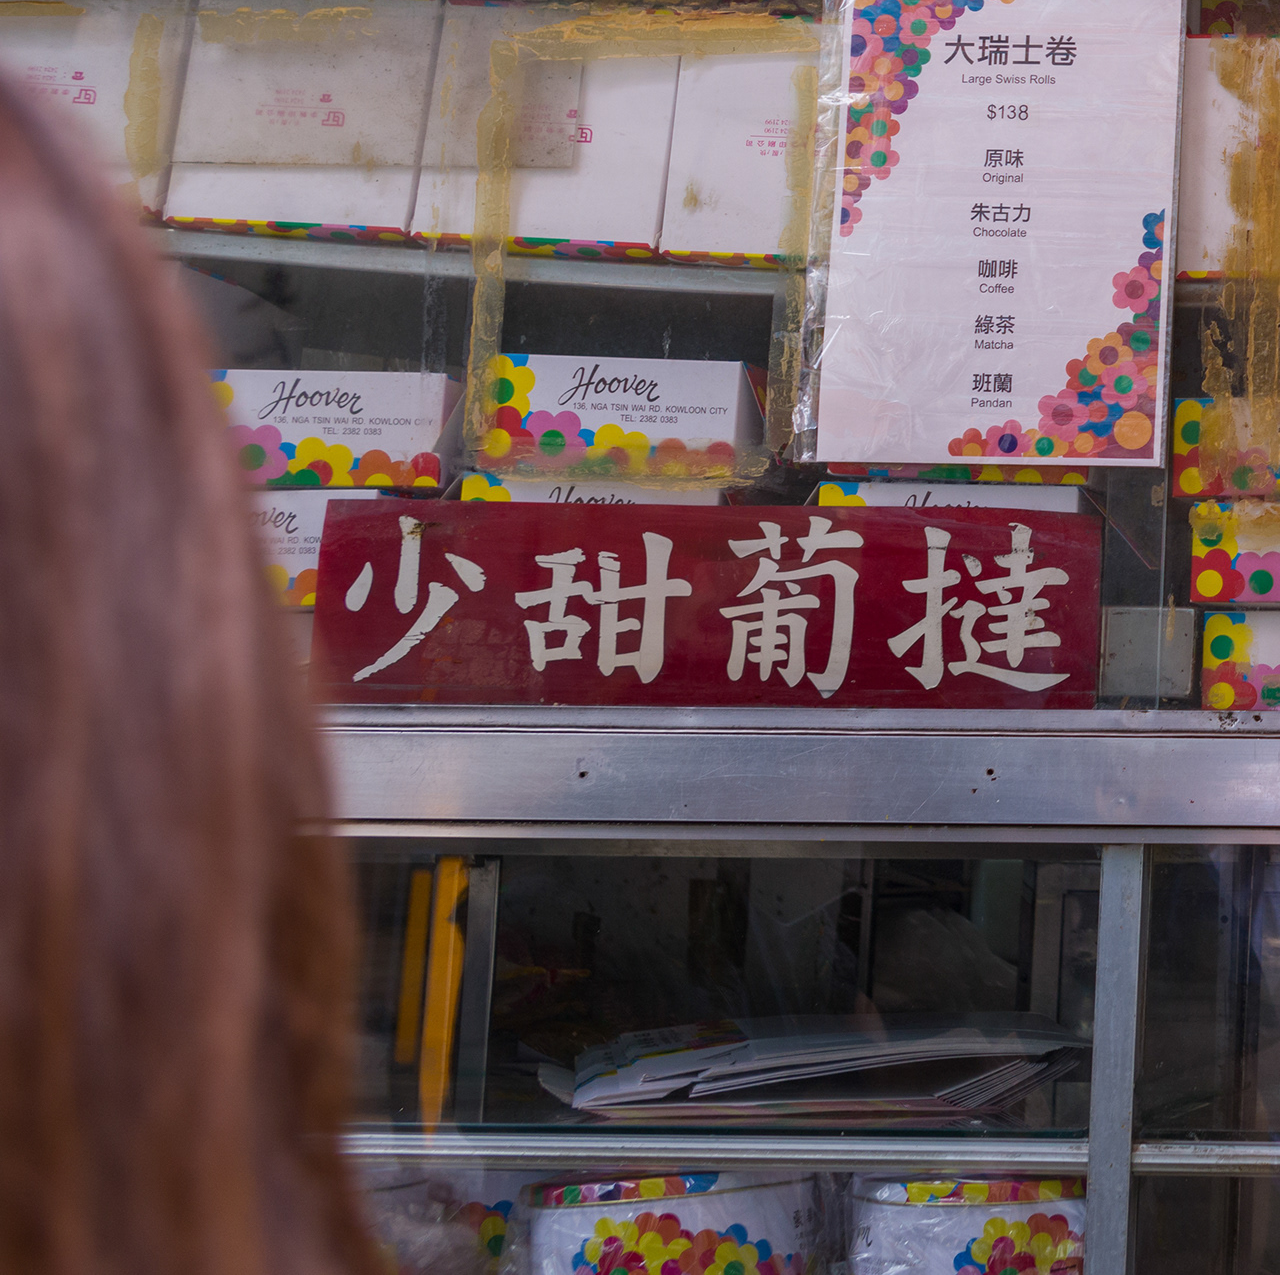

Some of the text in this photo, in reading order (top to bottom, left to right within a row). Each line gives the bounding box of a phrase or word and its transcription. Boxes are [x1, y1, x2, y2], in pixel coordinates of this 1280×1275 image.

[943, 34, 1077, 66] 大瑞士卷
[961, 74, 1056, 86] Large Swiss Rolls
[986, 103, 1029, 120] $138
[984, 148, 1024, 168] 原味
[982, 172, 1024, 185] Original
[970, 203, 1031, 223] 朱古力
[973, 227, 1027, 238] Chocolate
[977, 259, 1018, 279] 咖啡
[979, 283, 1015, 294] Coffee
[974, 314, 1015, 335] 綠茶
[974, 340, 1014, 350] Matcha
[558, 364, 660, 406] Hoover
[972, 373, 1013, 393] 班蘭
[258, 378, 363, 419] Hoover
[971, 397, 1013, 408] Pandan
[573, 402, 588, 411] 136,
[590, 403, 608, 411] NGA
[631, 404, 647, 412] WAI
[665, 405, 707, 414] KOWLOON
[709, 407, 728, 415] CITY
[369, 418, 411, 426] KOWLOON
[620, 414, 678, 424] TEL: 2382 0383
[322, 427, 382, 436] TEL: 2382 0383
[345, 515, 1071, 698] 少甜葡撻
